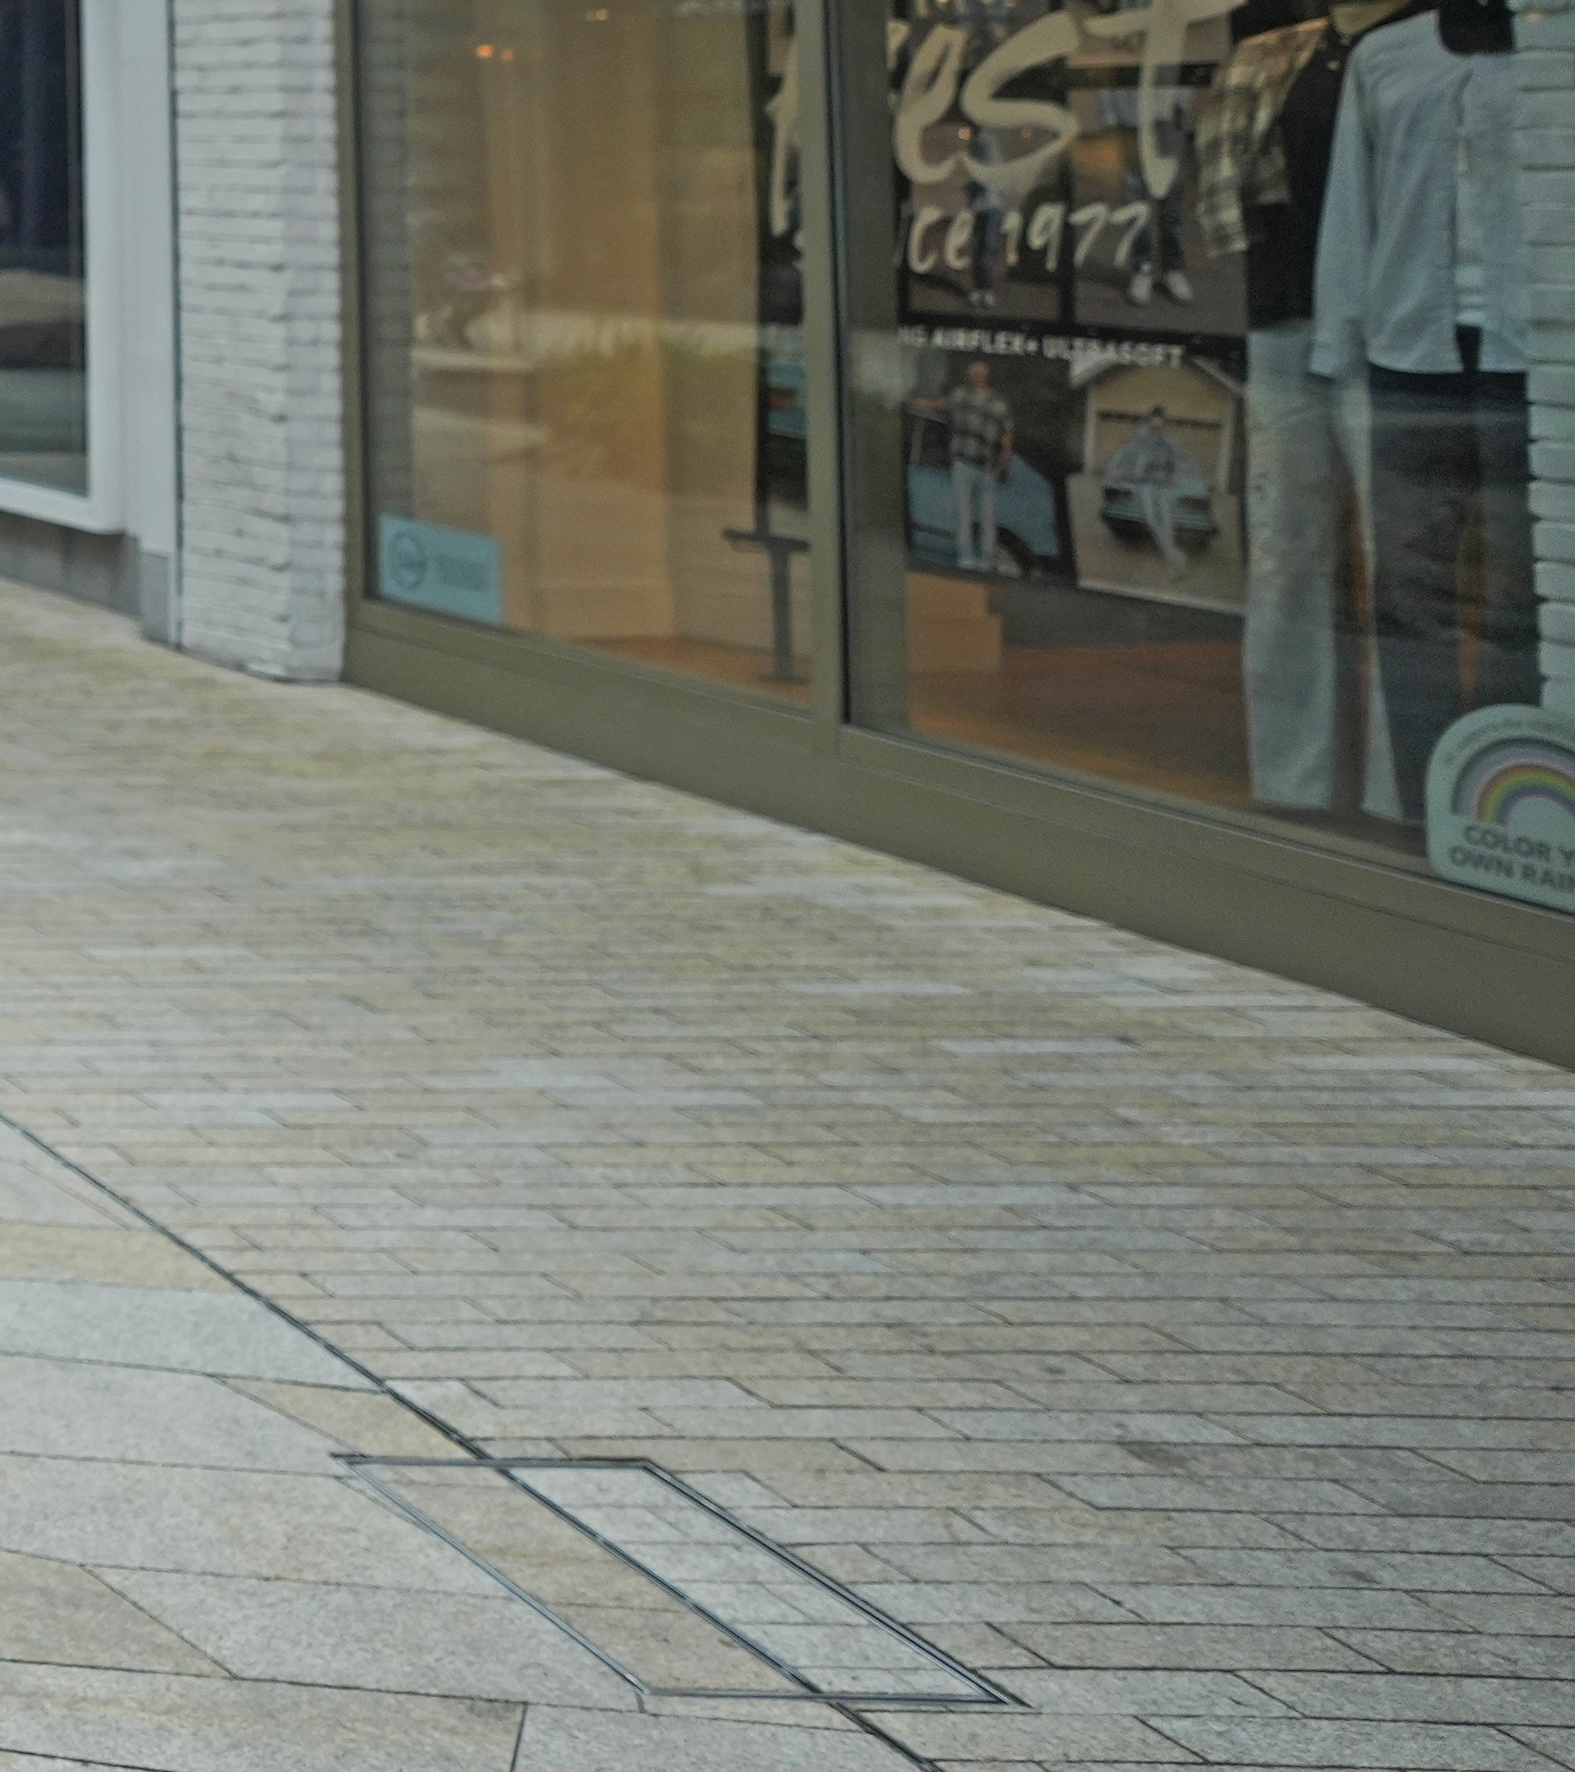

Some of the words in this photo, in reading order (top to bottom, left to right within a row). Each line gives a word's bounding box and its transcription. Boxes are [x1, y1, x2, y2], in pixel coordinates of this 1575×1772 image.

[1000, 200, 1152, 271] 1977
[1448, 845, 1514, 879] OWN
[1464, 825, 1550, 862] COLOR
